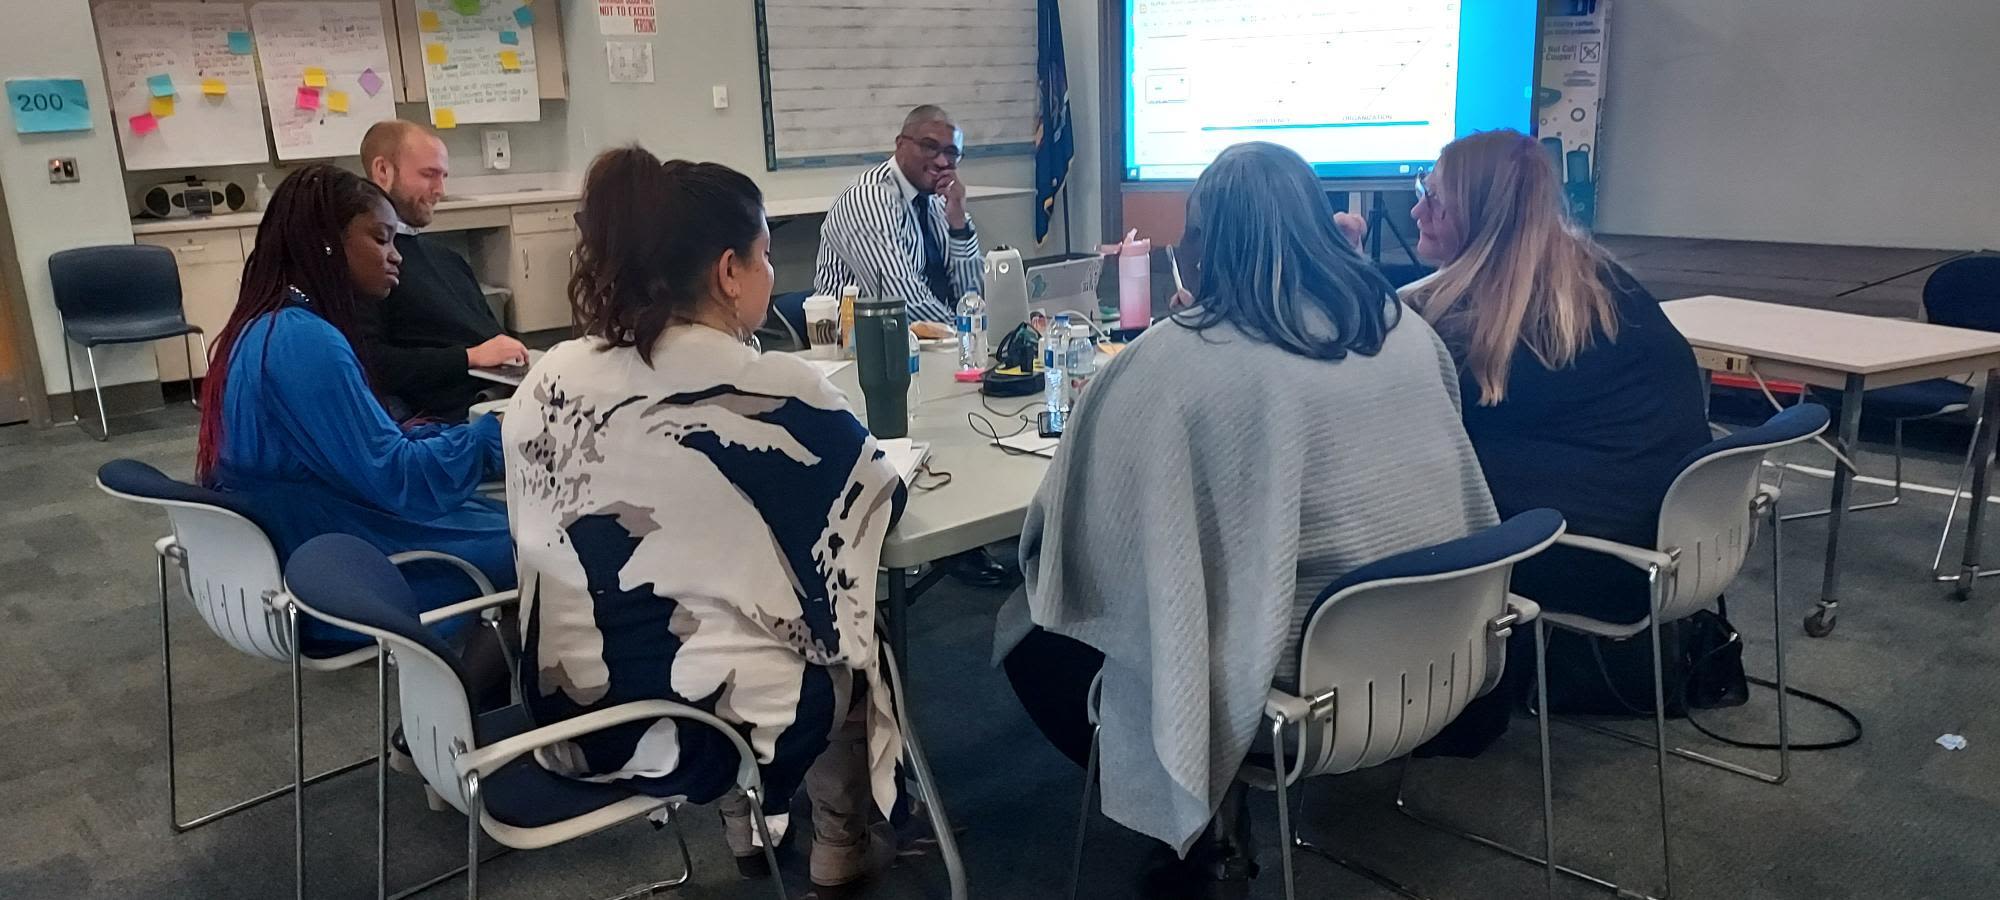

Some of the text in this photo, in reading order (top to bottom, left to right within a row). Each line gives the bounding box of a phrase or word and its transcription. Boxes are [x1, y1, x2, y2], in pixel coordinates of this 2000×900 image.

[600, 6, 655, 16] NOT TO EXCEED
[633, 18, 656, 33] PERSONS
[17, 93, 63, 112] 200
[1342, 112, 1393, 122] ORGANIZATION
